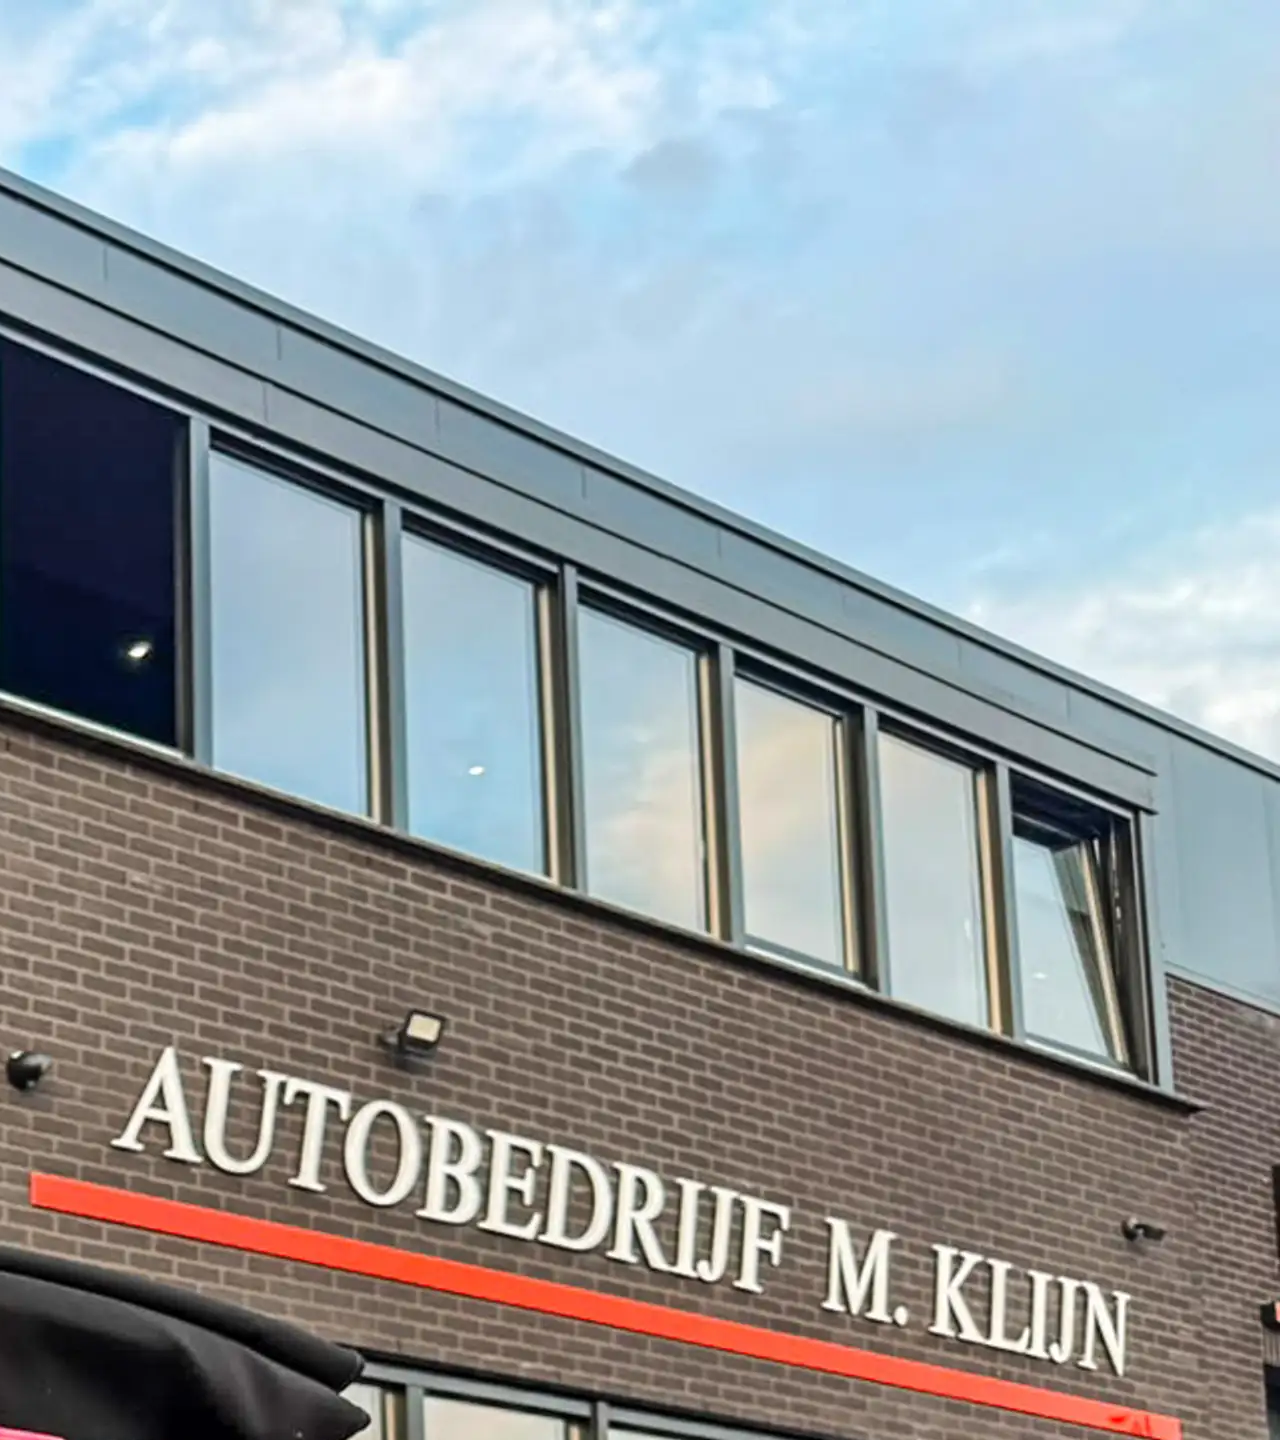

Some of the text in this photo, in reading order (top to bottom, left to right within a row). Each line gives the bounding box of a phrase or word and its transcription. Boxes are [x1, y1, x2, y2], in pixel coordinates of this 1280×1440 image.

[111, 1045, 1133, 1378] AUTOBEDRIJF M. KLIJN
